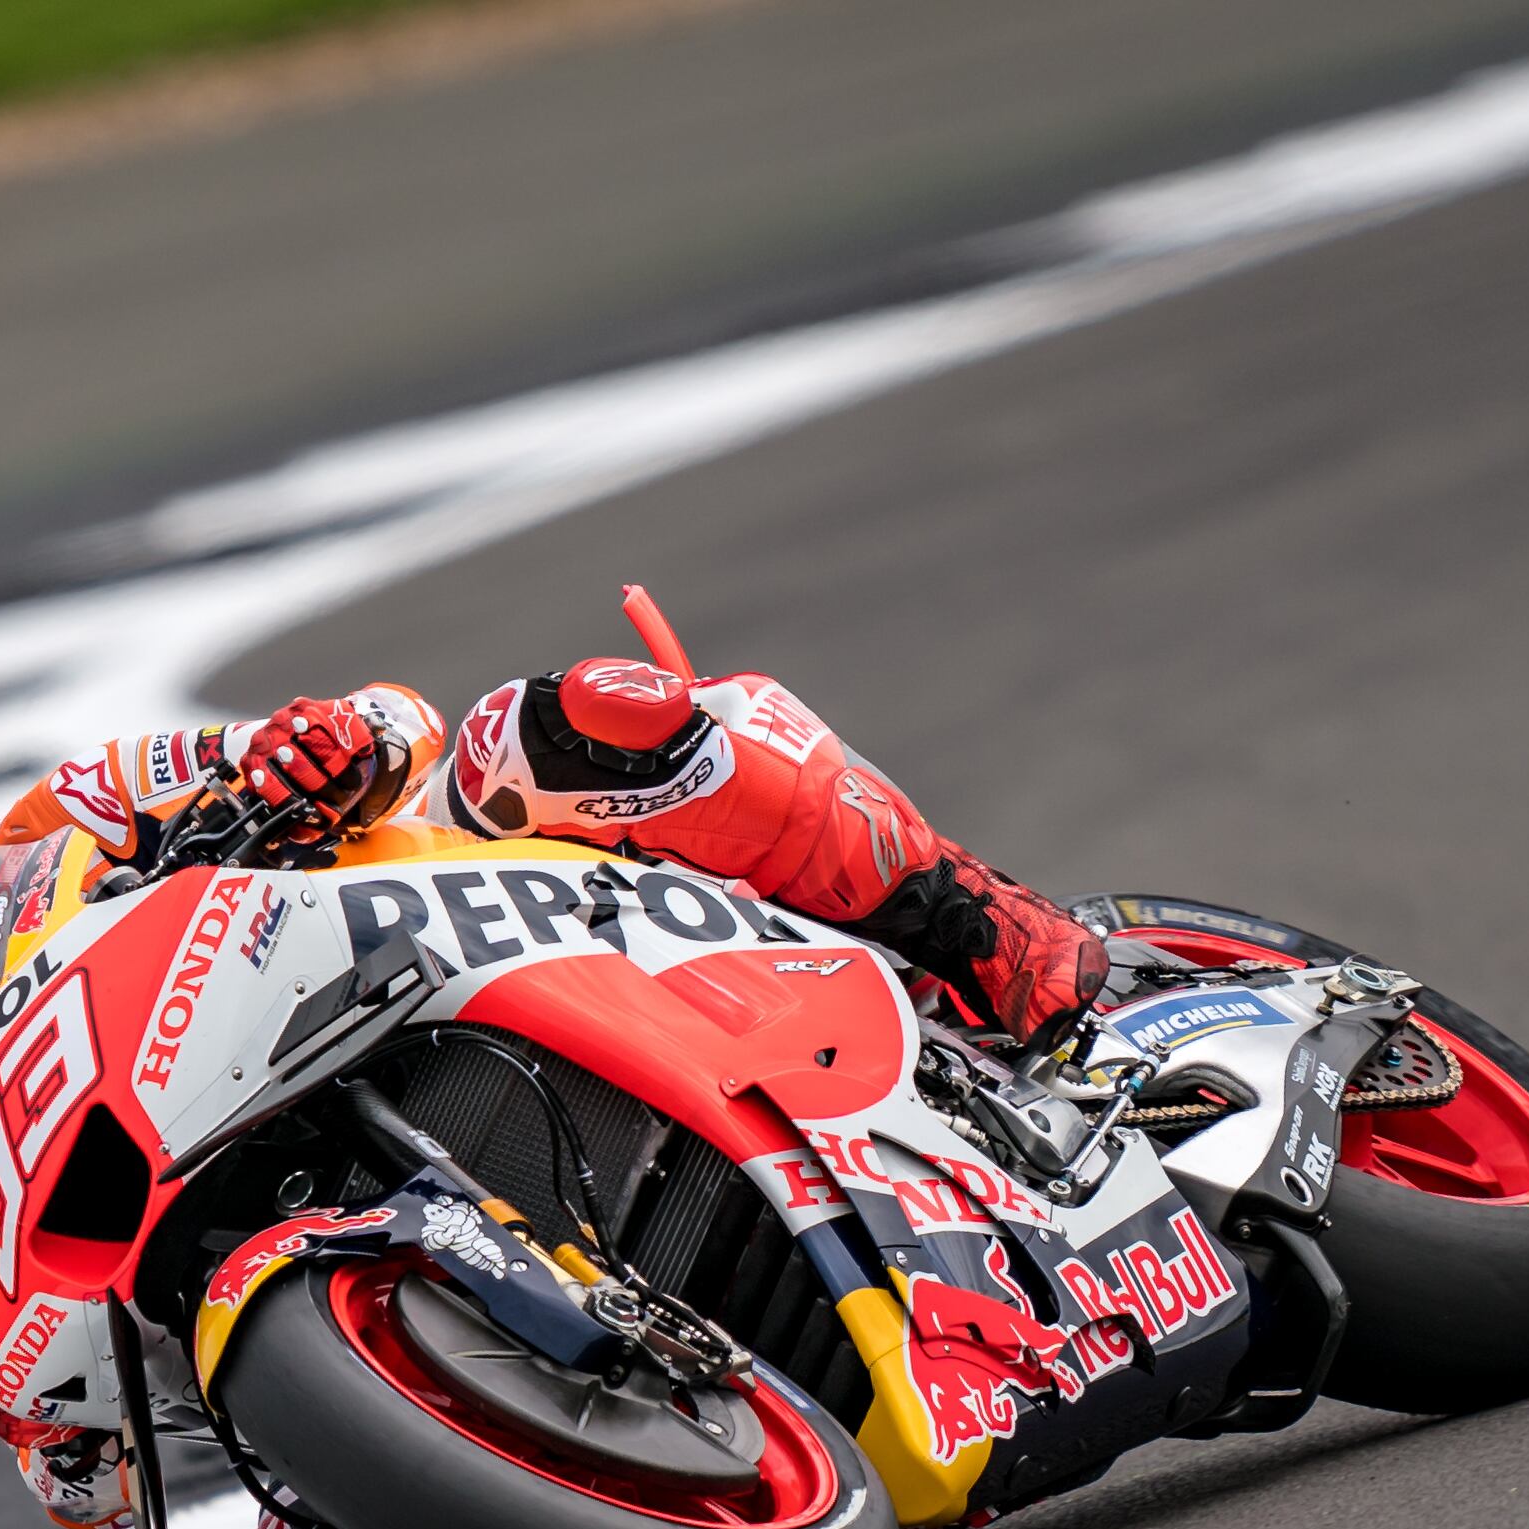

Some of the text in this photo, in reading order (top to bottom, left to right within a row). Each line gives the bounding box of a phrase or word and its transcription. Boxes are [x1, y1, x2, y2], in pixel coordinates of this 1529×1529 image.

[575, 756, 714, 820] alpinestars
[240, 883, 286, 970] HRC
[138, 874, 254, 1090] HONDA
[1131, 1001, 1259, 1049] MICHELIN
[774, 1130, 1049, 1228] HONDA
[1300, 1134, 1333, 1185] RK
[1057, 1207, 1237, 1384] Red Bull
